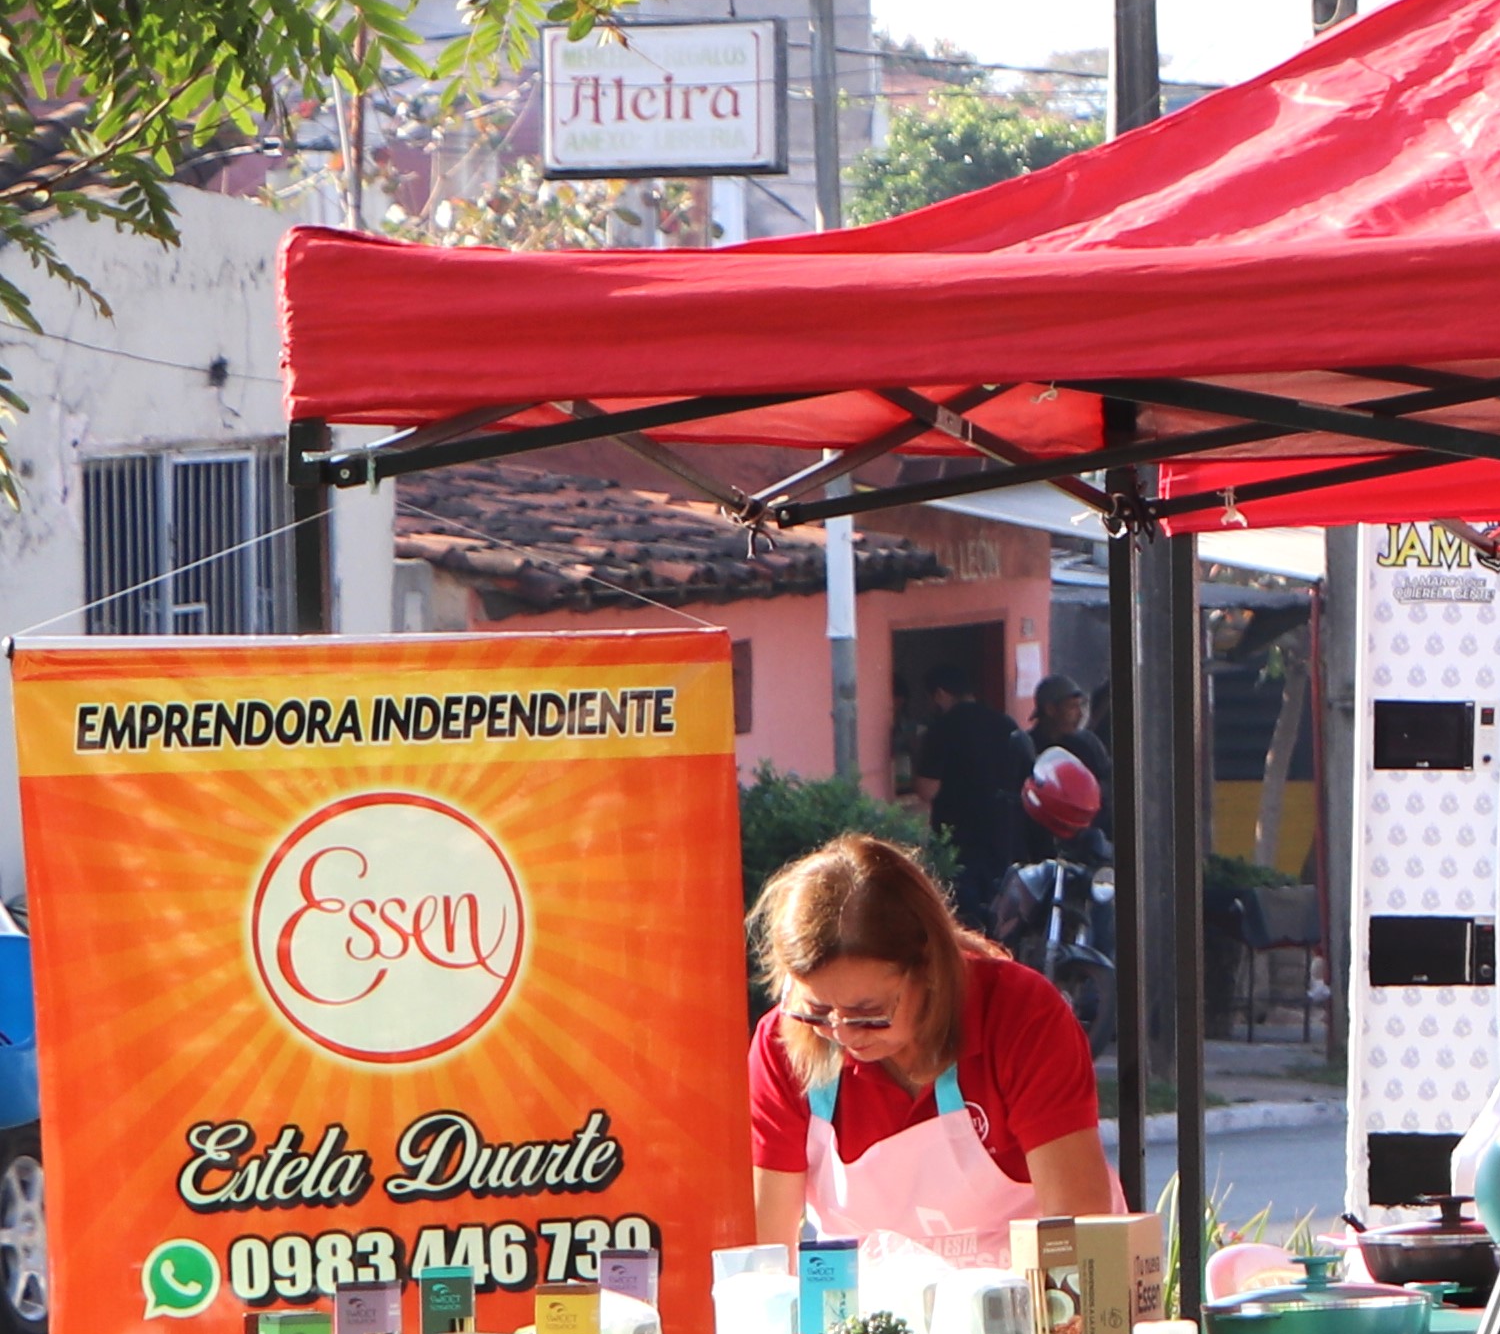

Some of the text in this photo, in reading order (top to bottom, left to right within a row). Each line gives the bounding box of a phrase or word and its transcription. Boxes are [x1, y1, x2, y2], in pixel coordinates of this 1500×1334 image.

[561, 74, 741, 125] Alcira
[1377, 523, 1472, 570] JAM
[1419, 576, 1456, 587] MARCA
[75, 688, 675, 752] EMPRENDORA INDEPENDIENTE
[277, 846, 507, 1006] Essen
[178, 1110, 621, 1207] Estela Duarte
[231, 1228, 397, 1300] 0983
[411, 1223, 528, 1287] 446
